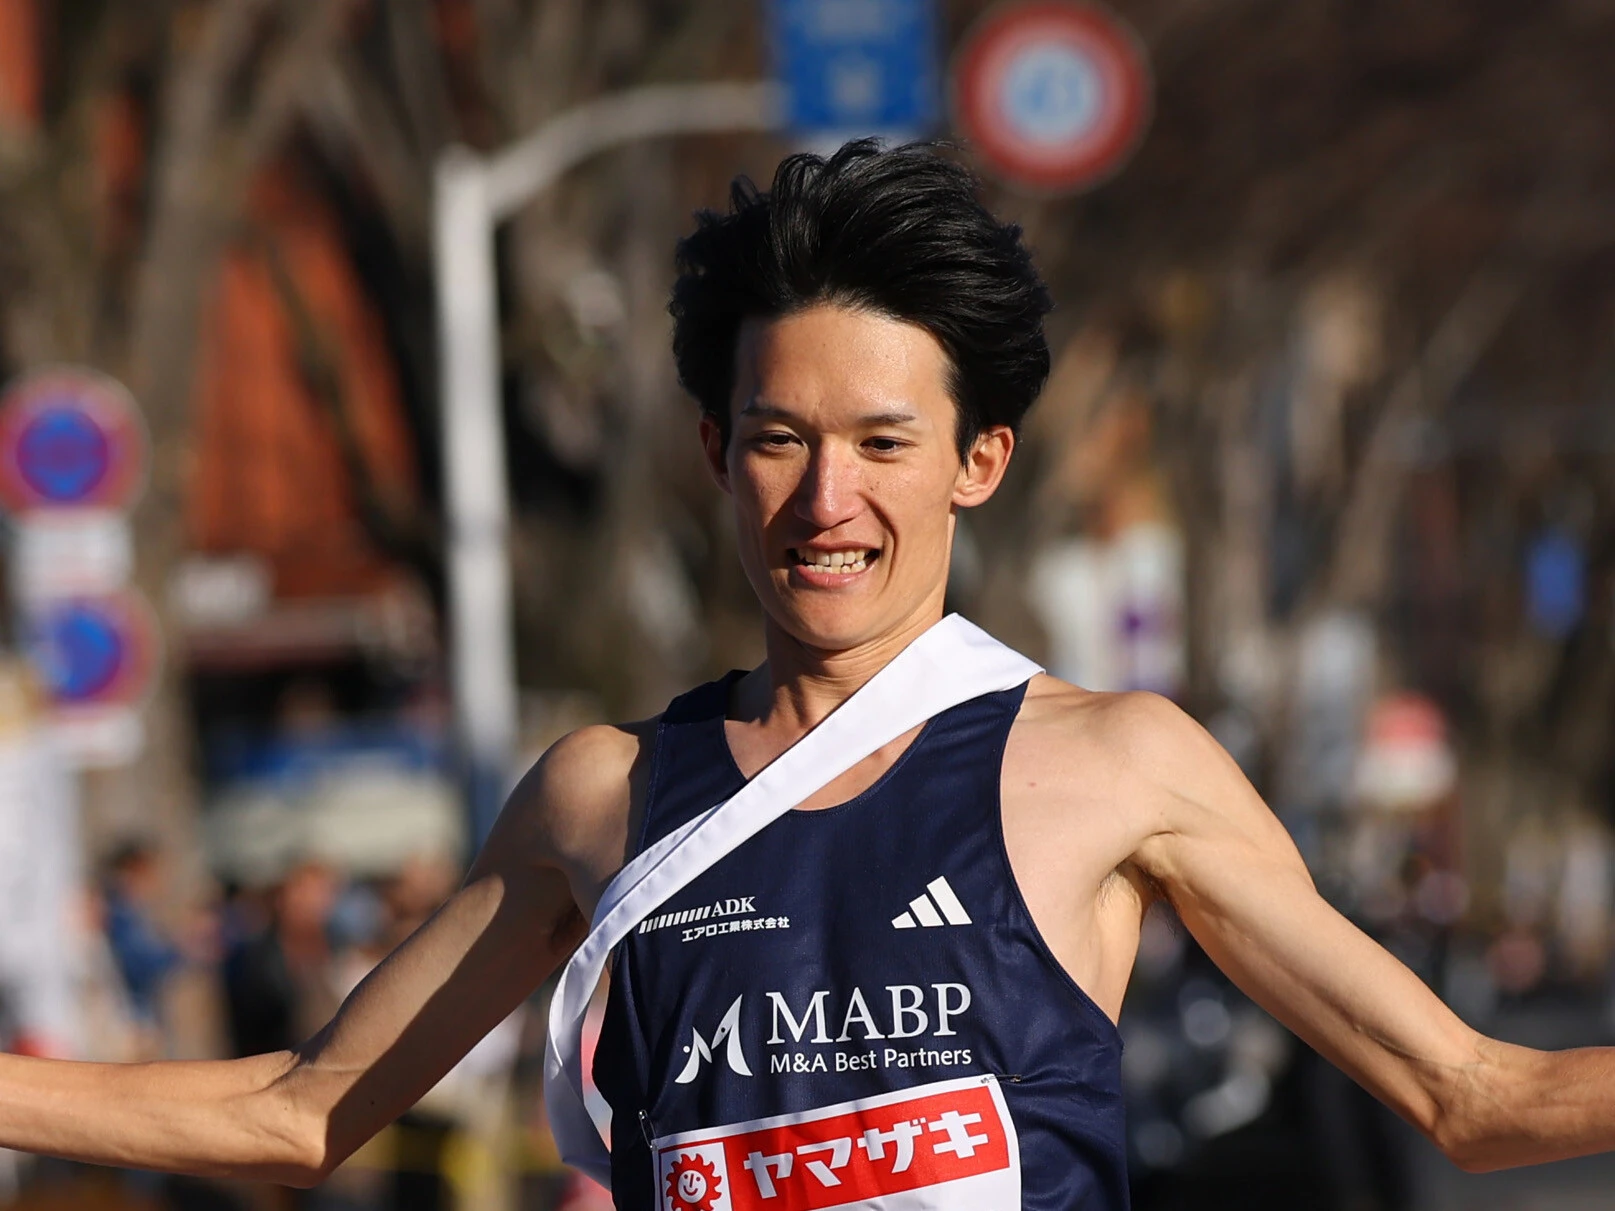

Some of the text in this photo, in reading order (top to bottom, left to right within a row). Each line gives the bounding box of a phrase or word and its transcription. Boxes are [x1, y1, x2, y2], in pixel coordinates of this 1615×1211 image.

[711, 896, 757, 918] ADK
[681, 916, 790, 943] エアロ工業株式会社
[765, 982, 972, 1045] MABP
[770, 1047, 973, 1074] M&A Best Partners
[743, 1109, 989, 1199] ヤマザキ
